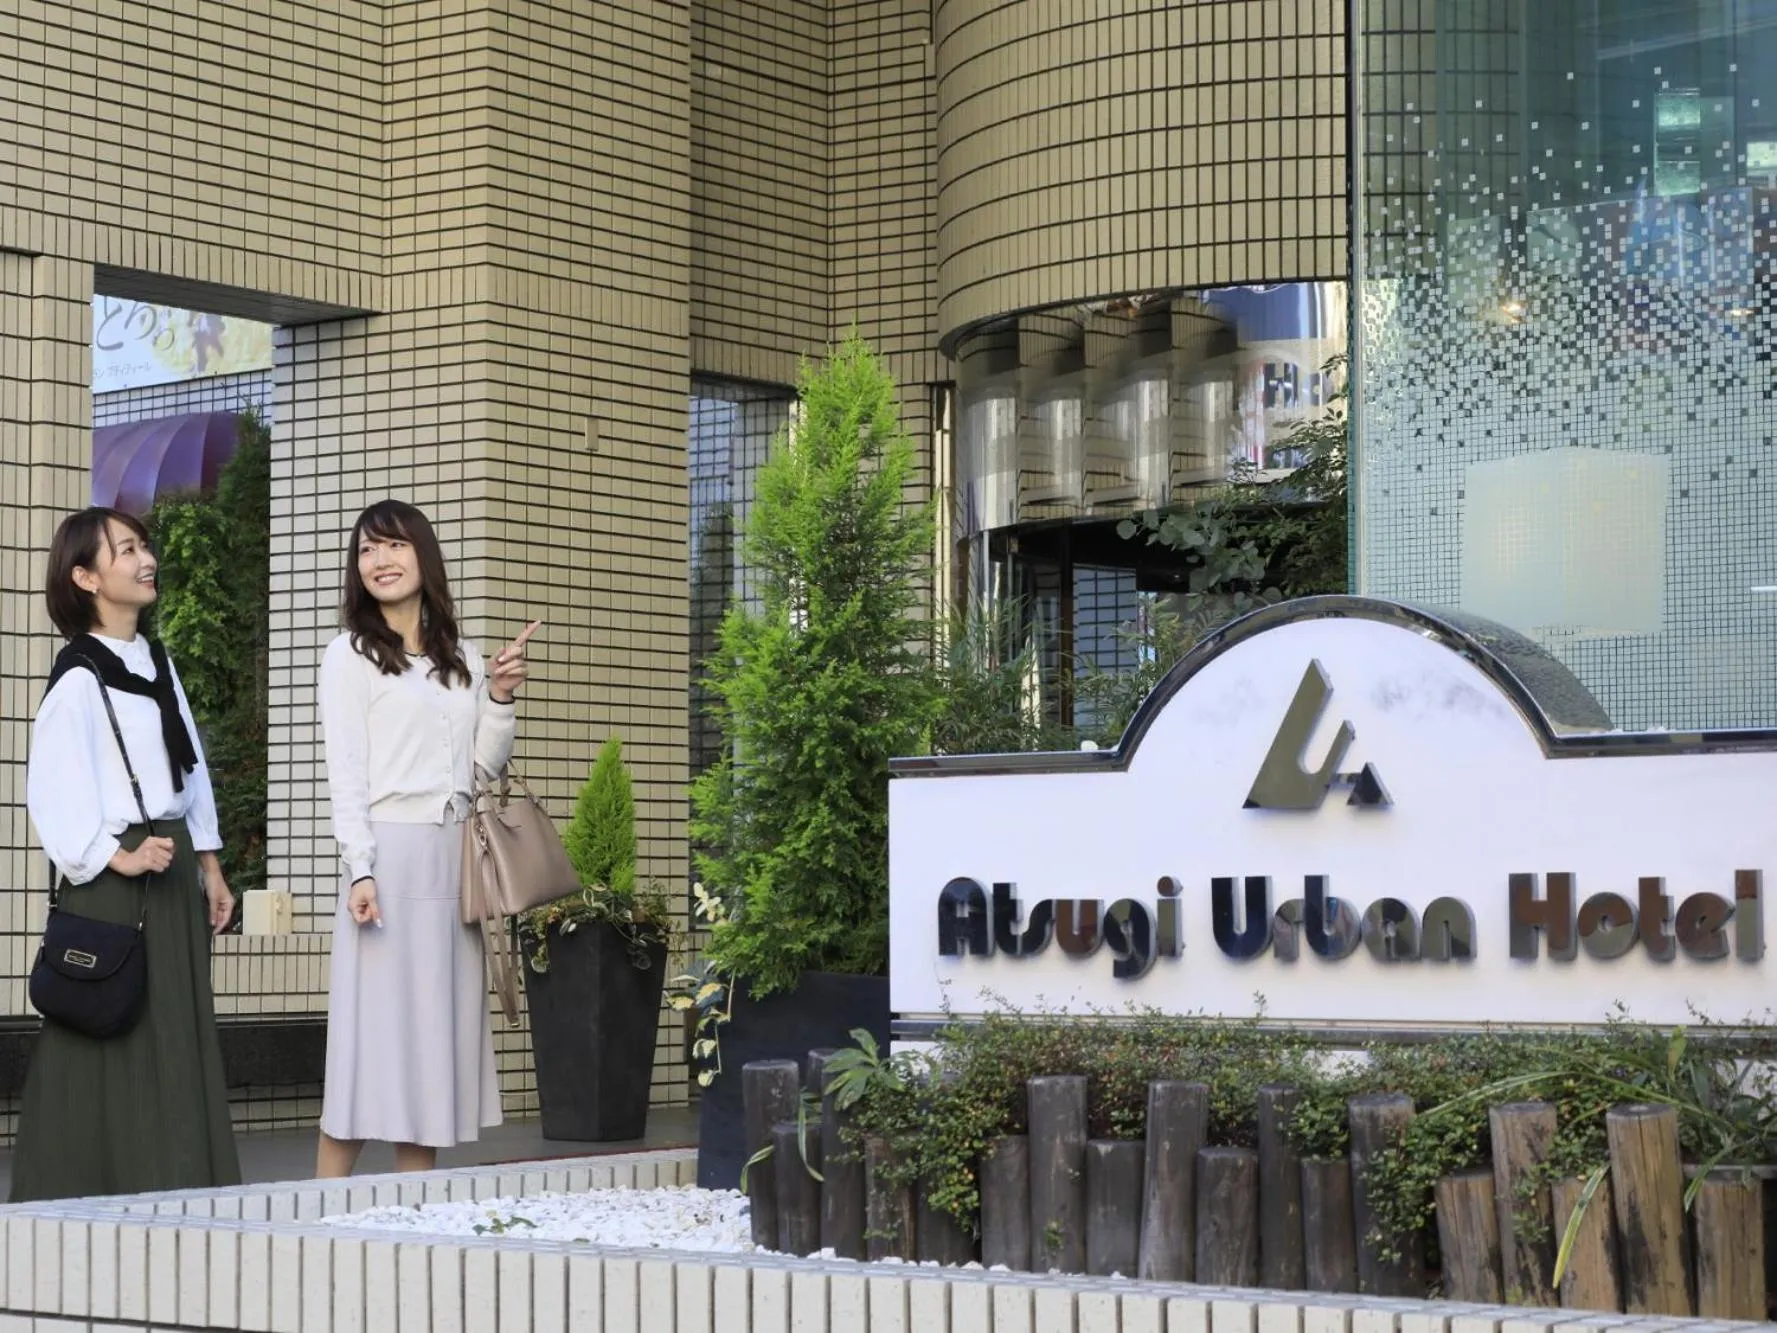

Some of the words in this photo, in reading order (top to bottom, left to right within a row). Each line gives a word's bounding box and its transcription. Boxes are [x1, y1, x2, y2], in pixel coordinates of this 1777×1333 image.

[938, 876, 1184, 979] Atsugi
[1211, 875, 1477, 962] Urban
[1509, 869, 1766, 963] Hotel
